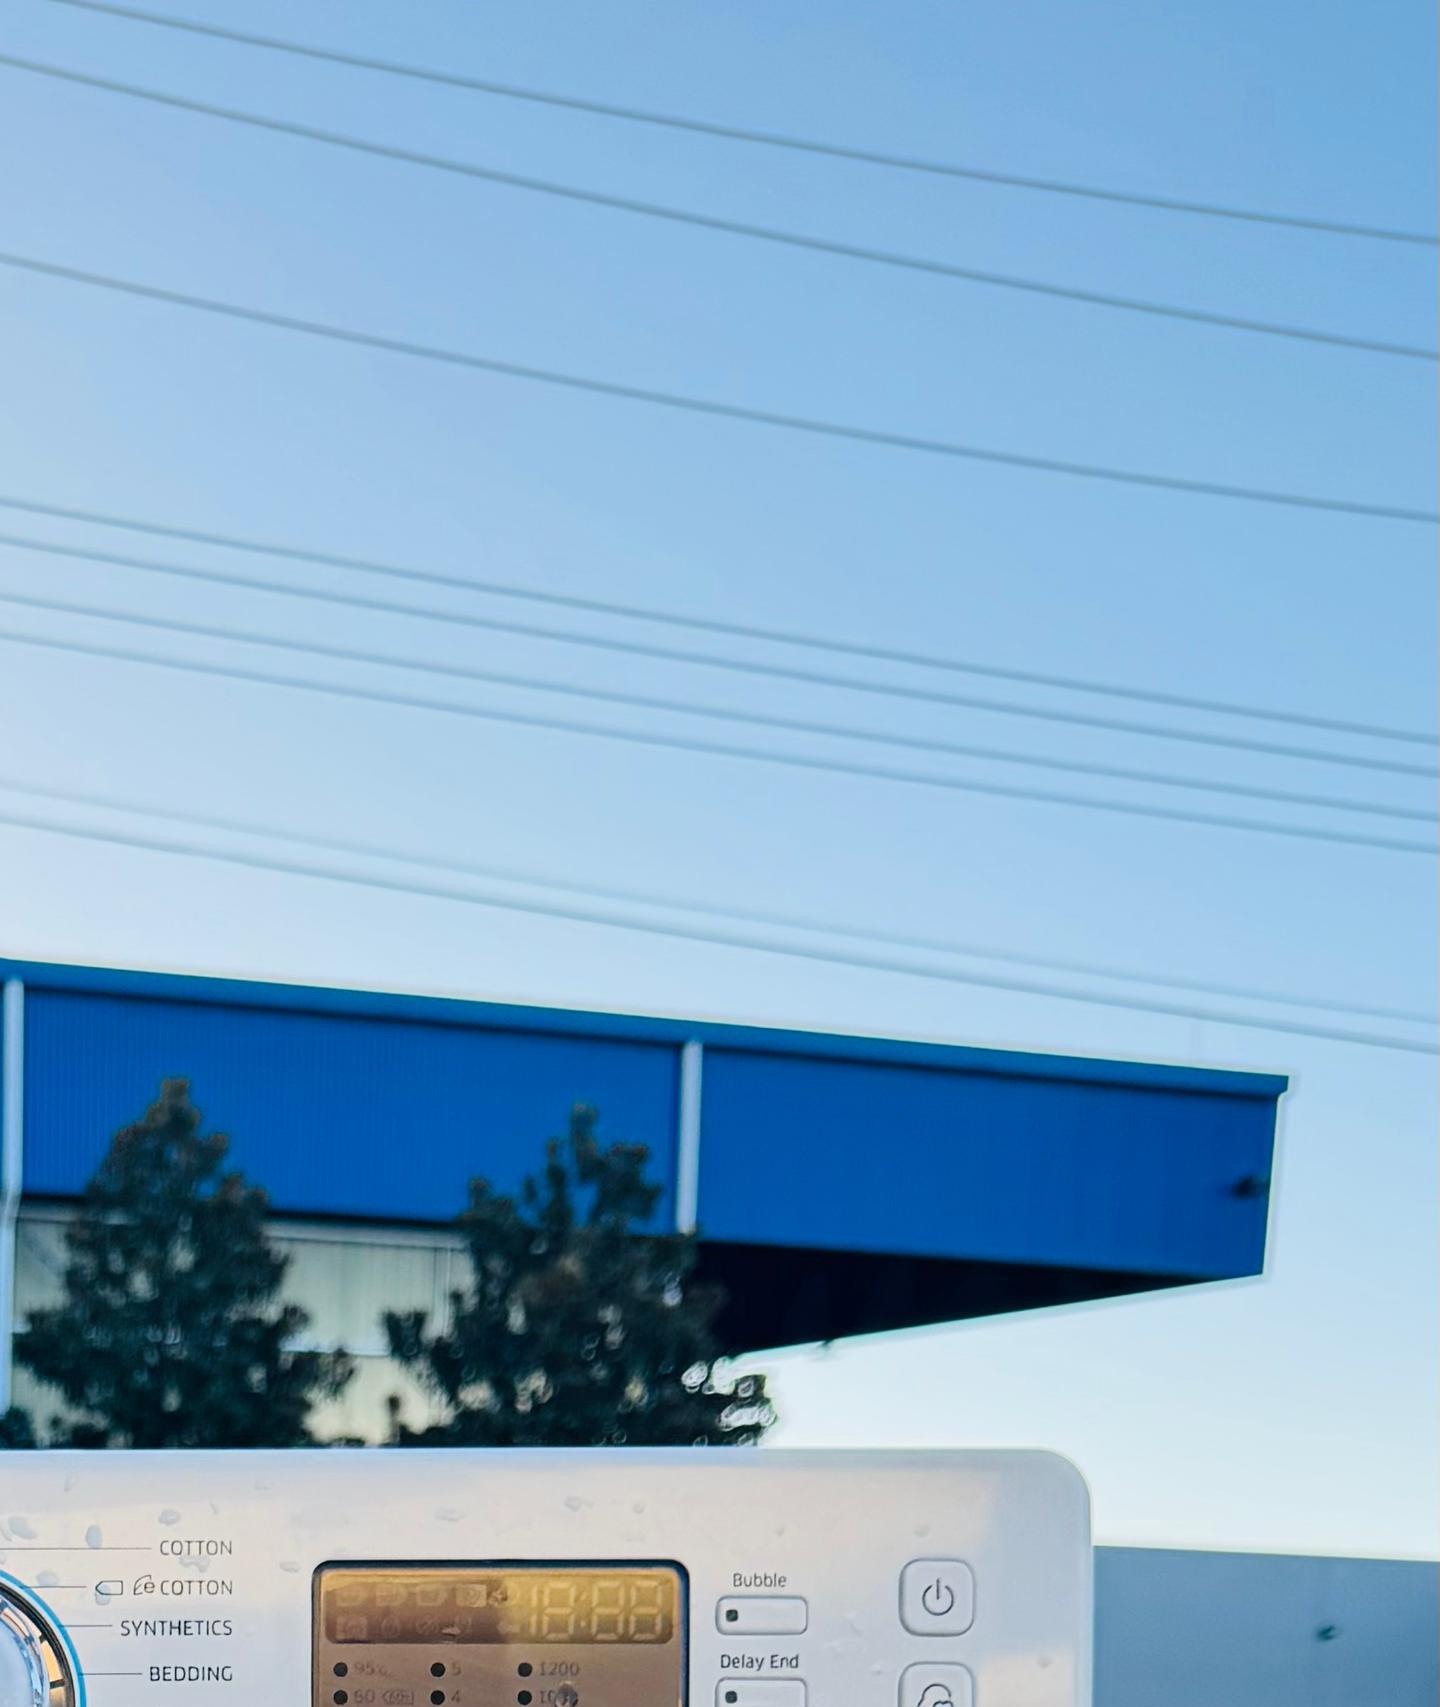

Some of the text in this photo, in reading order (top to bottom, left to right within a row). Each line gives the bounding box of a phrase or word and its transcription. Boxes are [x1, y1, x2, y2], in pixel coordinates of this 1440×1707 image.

[160, 1540, 232, 1556] COTTON
[160, 1580, 233, 1596] COTTON
[732, 1572, 787, 1588] Bubble
[119, 1619, 233, 1637] SYNTHETICS
[539, 1661, 581, 1677] 1200
[720, 1653, 799, 1672] Delay End
[149, 1665, 233, 1682] BEDDING
